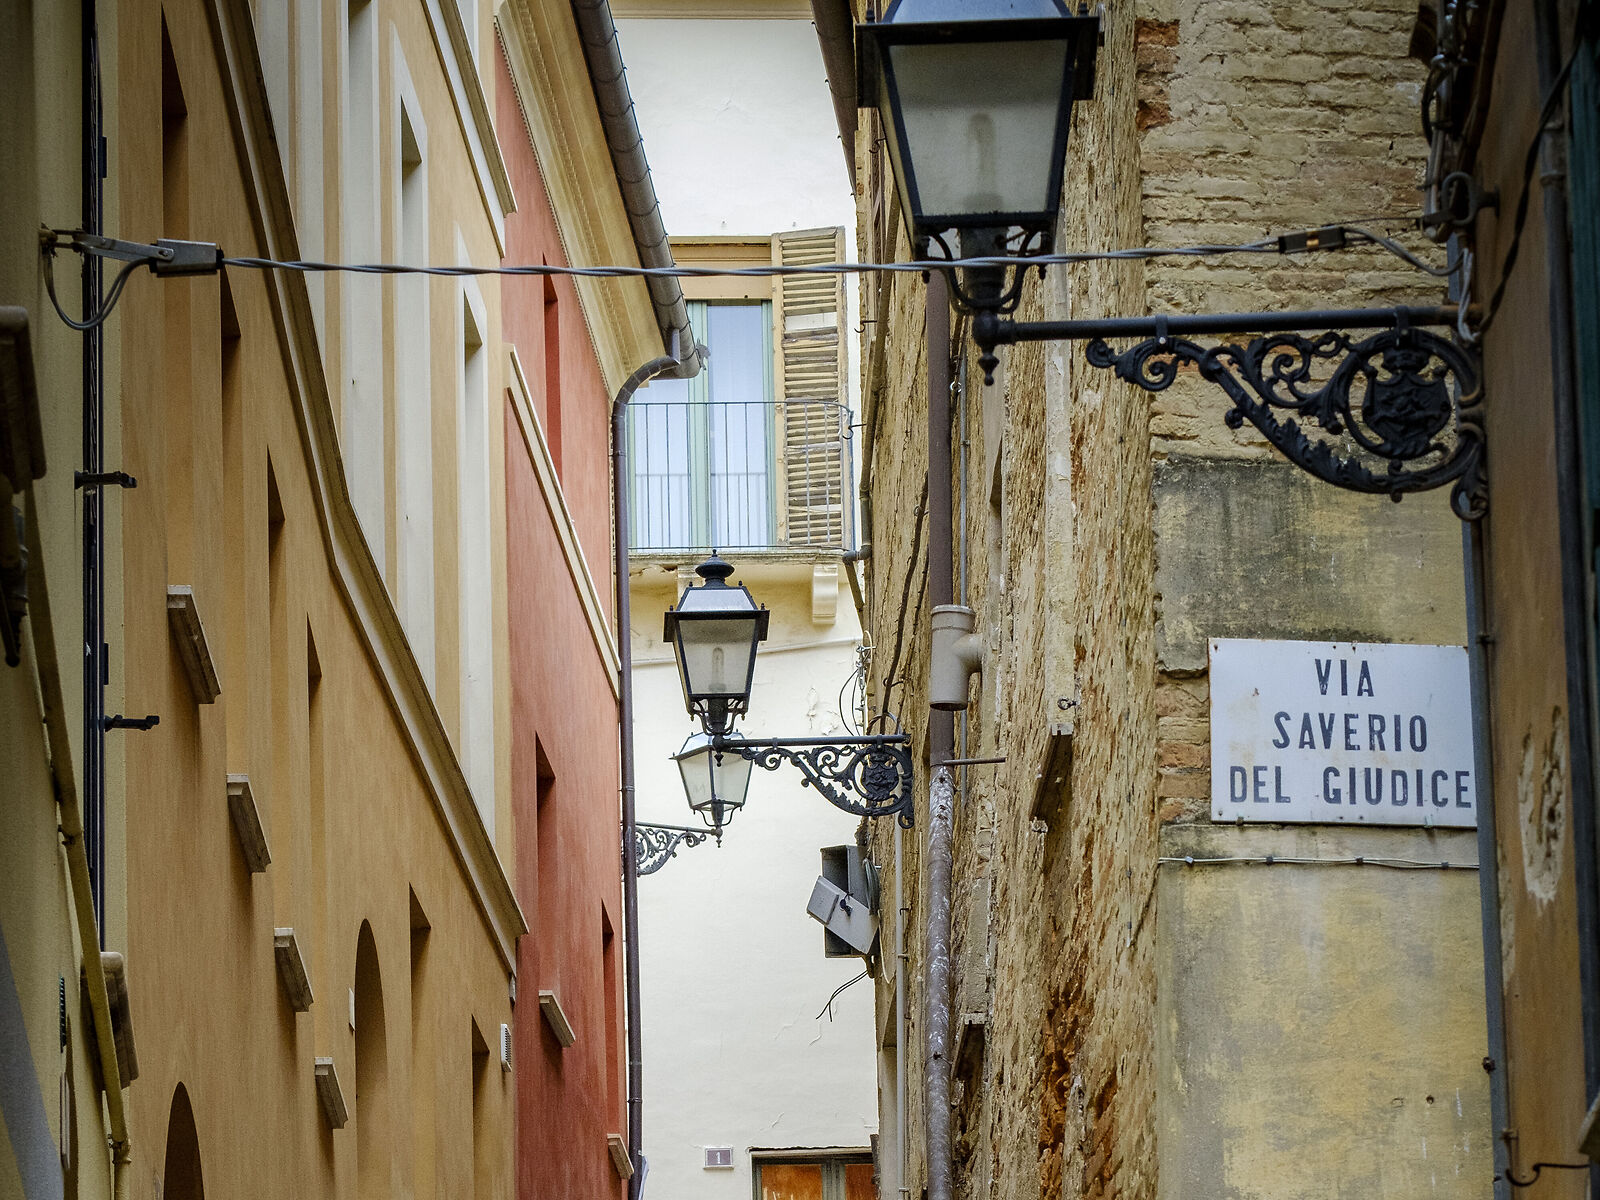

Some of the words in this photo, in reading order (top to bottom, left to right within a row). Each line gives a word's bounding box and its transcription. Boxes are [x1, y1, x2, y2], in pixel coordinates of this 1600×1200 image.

[1314, 658, 1375, 697] VIA
[1272, 711, 1428, 752] SAVERIO
[1229, 765, 1292, 803] DEL
[1322, 766, 1472, 808] GIUDICE
[715, 1151, 721, 1164] 1
